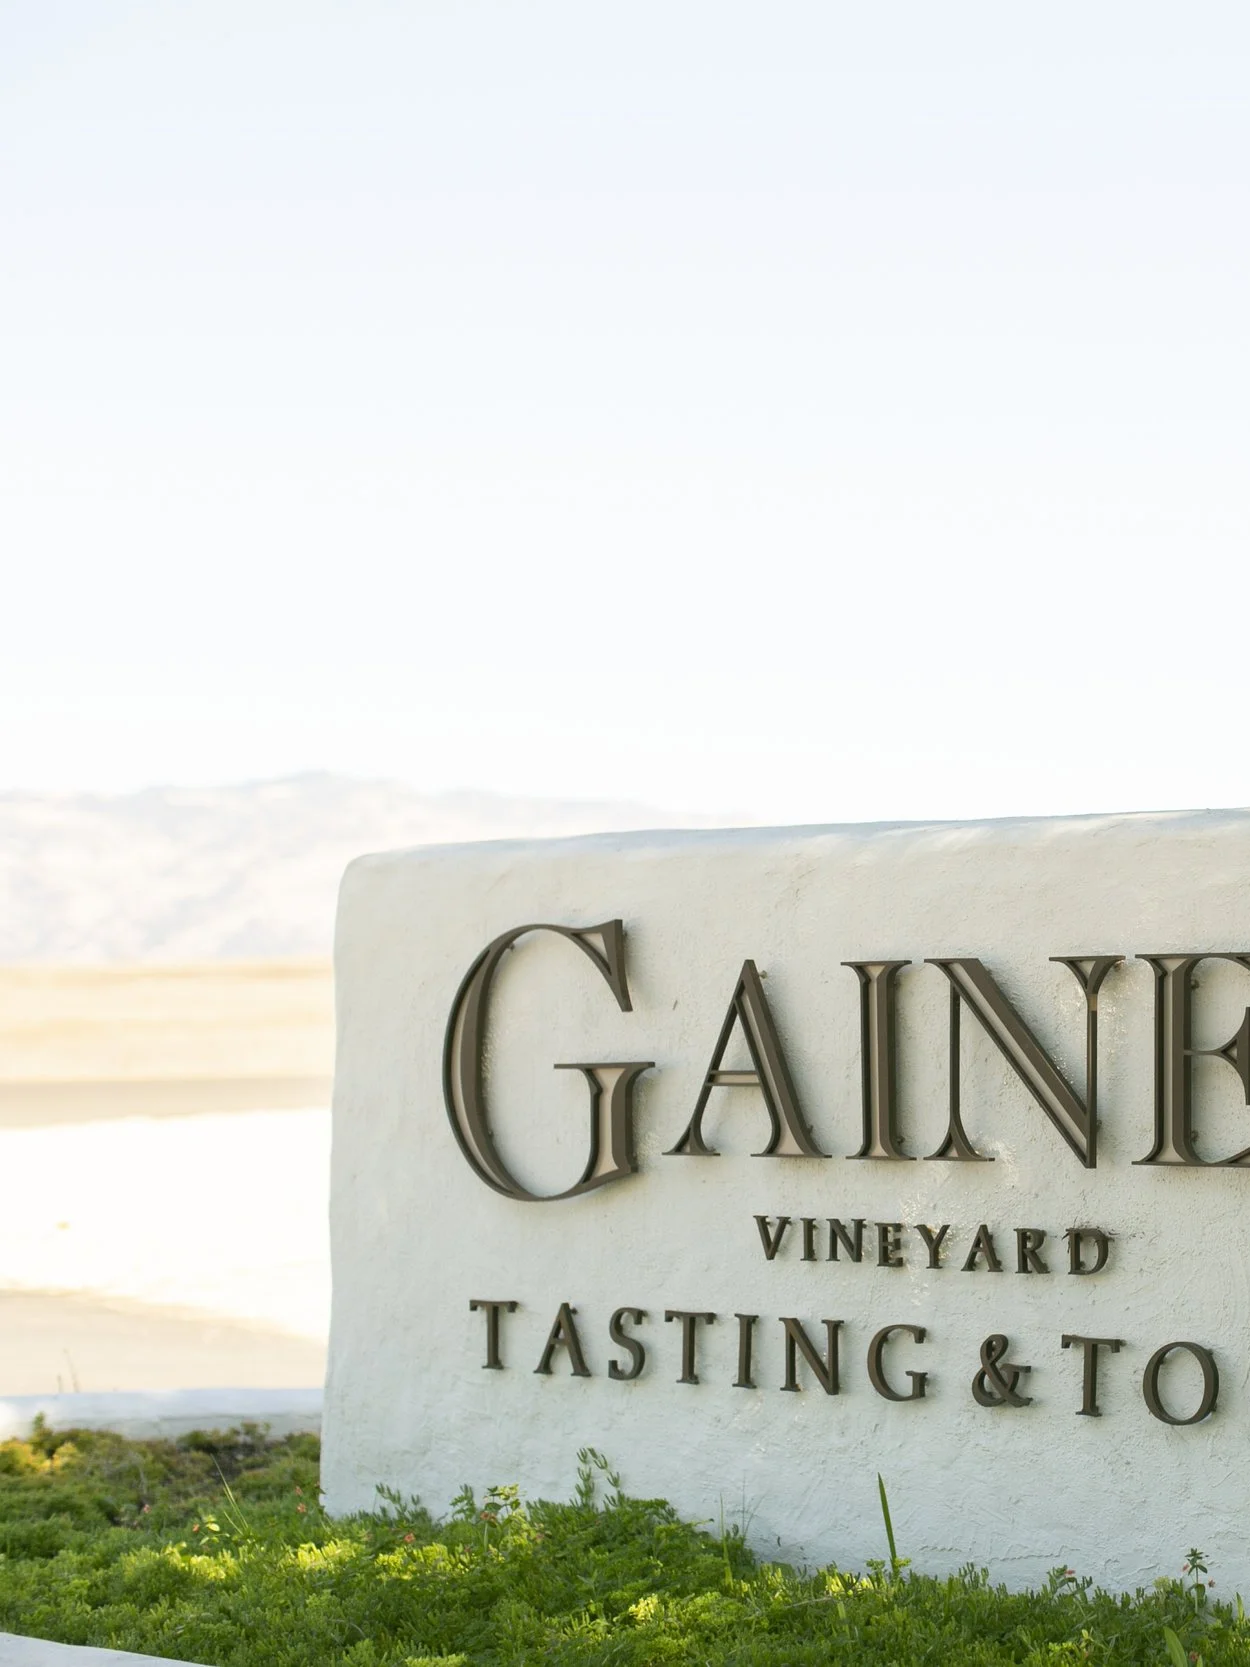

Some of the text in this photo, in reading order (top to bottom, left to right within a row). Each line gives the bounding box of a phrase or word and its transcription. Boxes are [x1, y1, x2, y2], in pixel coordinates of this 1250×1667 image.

[752, 1215, 1116, 1277] VINEYARD
[468, 1299, 936, 1403] TASTING
[971, 1333, 1038, 1410] &
